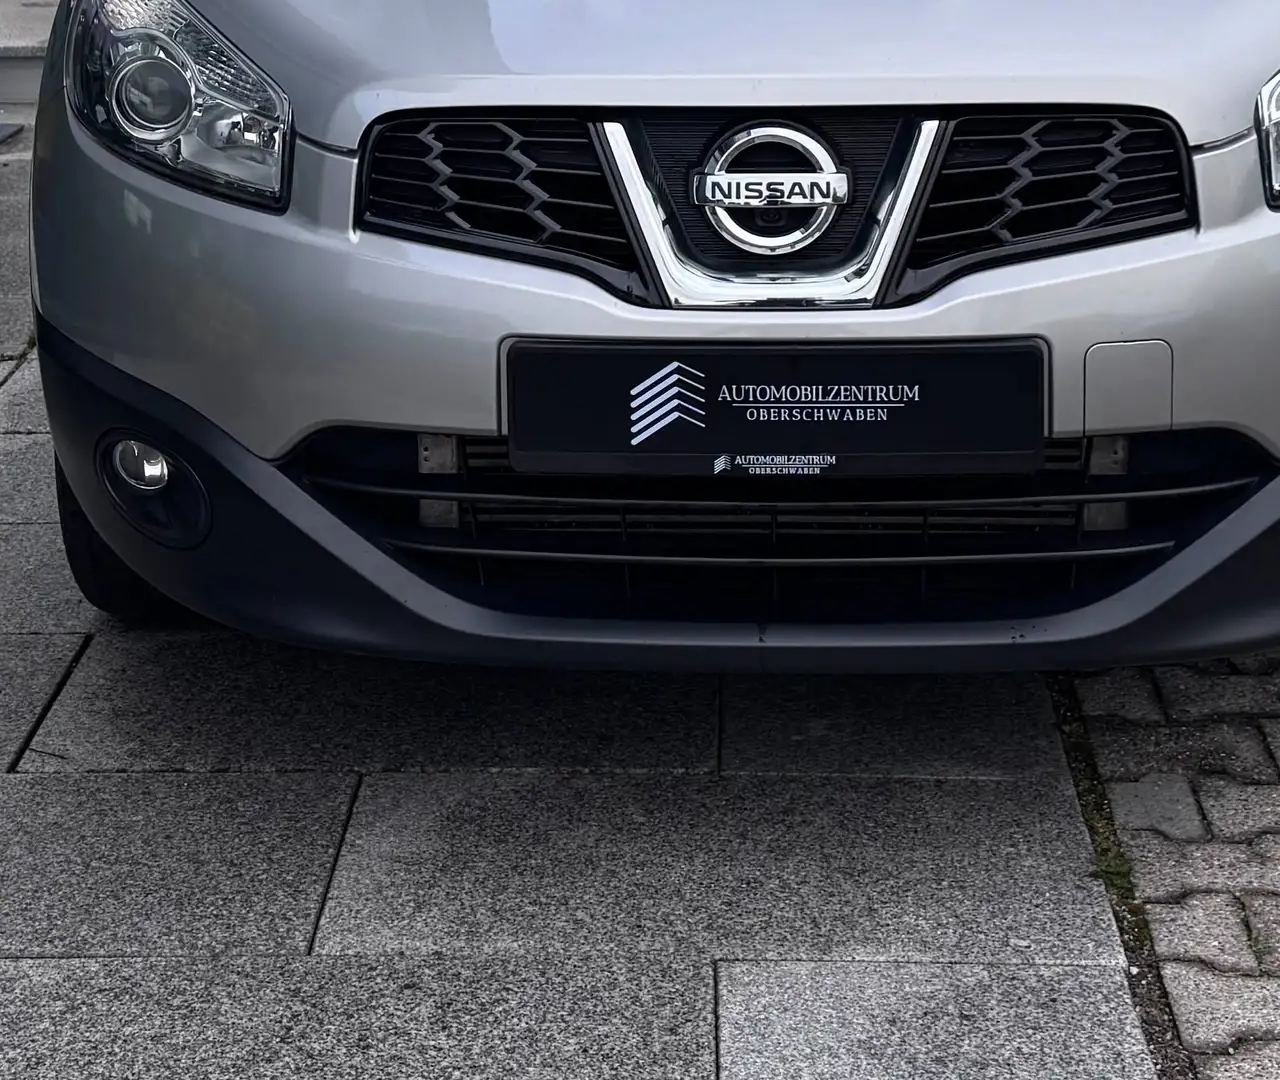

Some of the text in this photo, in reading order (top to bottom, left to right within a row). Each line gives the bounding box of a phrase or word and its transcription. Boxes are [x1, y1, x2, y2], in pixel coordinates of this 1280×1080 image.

[711, 181, 831, 200] NISSAN
[718, 384, 920, 402] AUTOMOBILZENTRUM
[746, 408, 888, 421] OBERSCHWABEN
[734, 455, 836, 465] AUTOMOBILZENTRUM
[748, 467, 821, 475] OBERSCHWABEN
